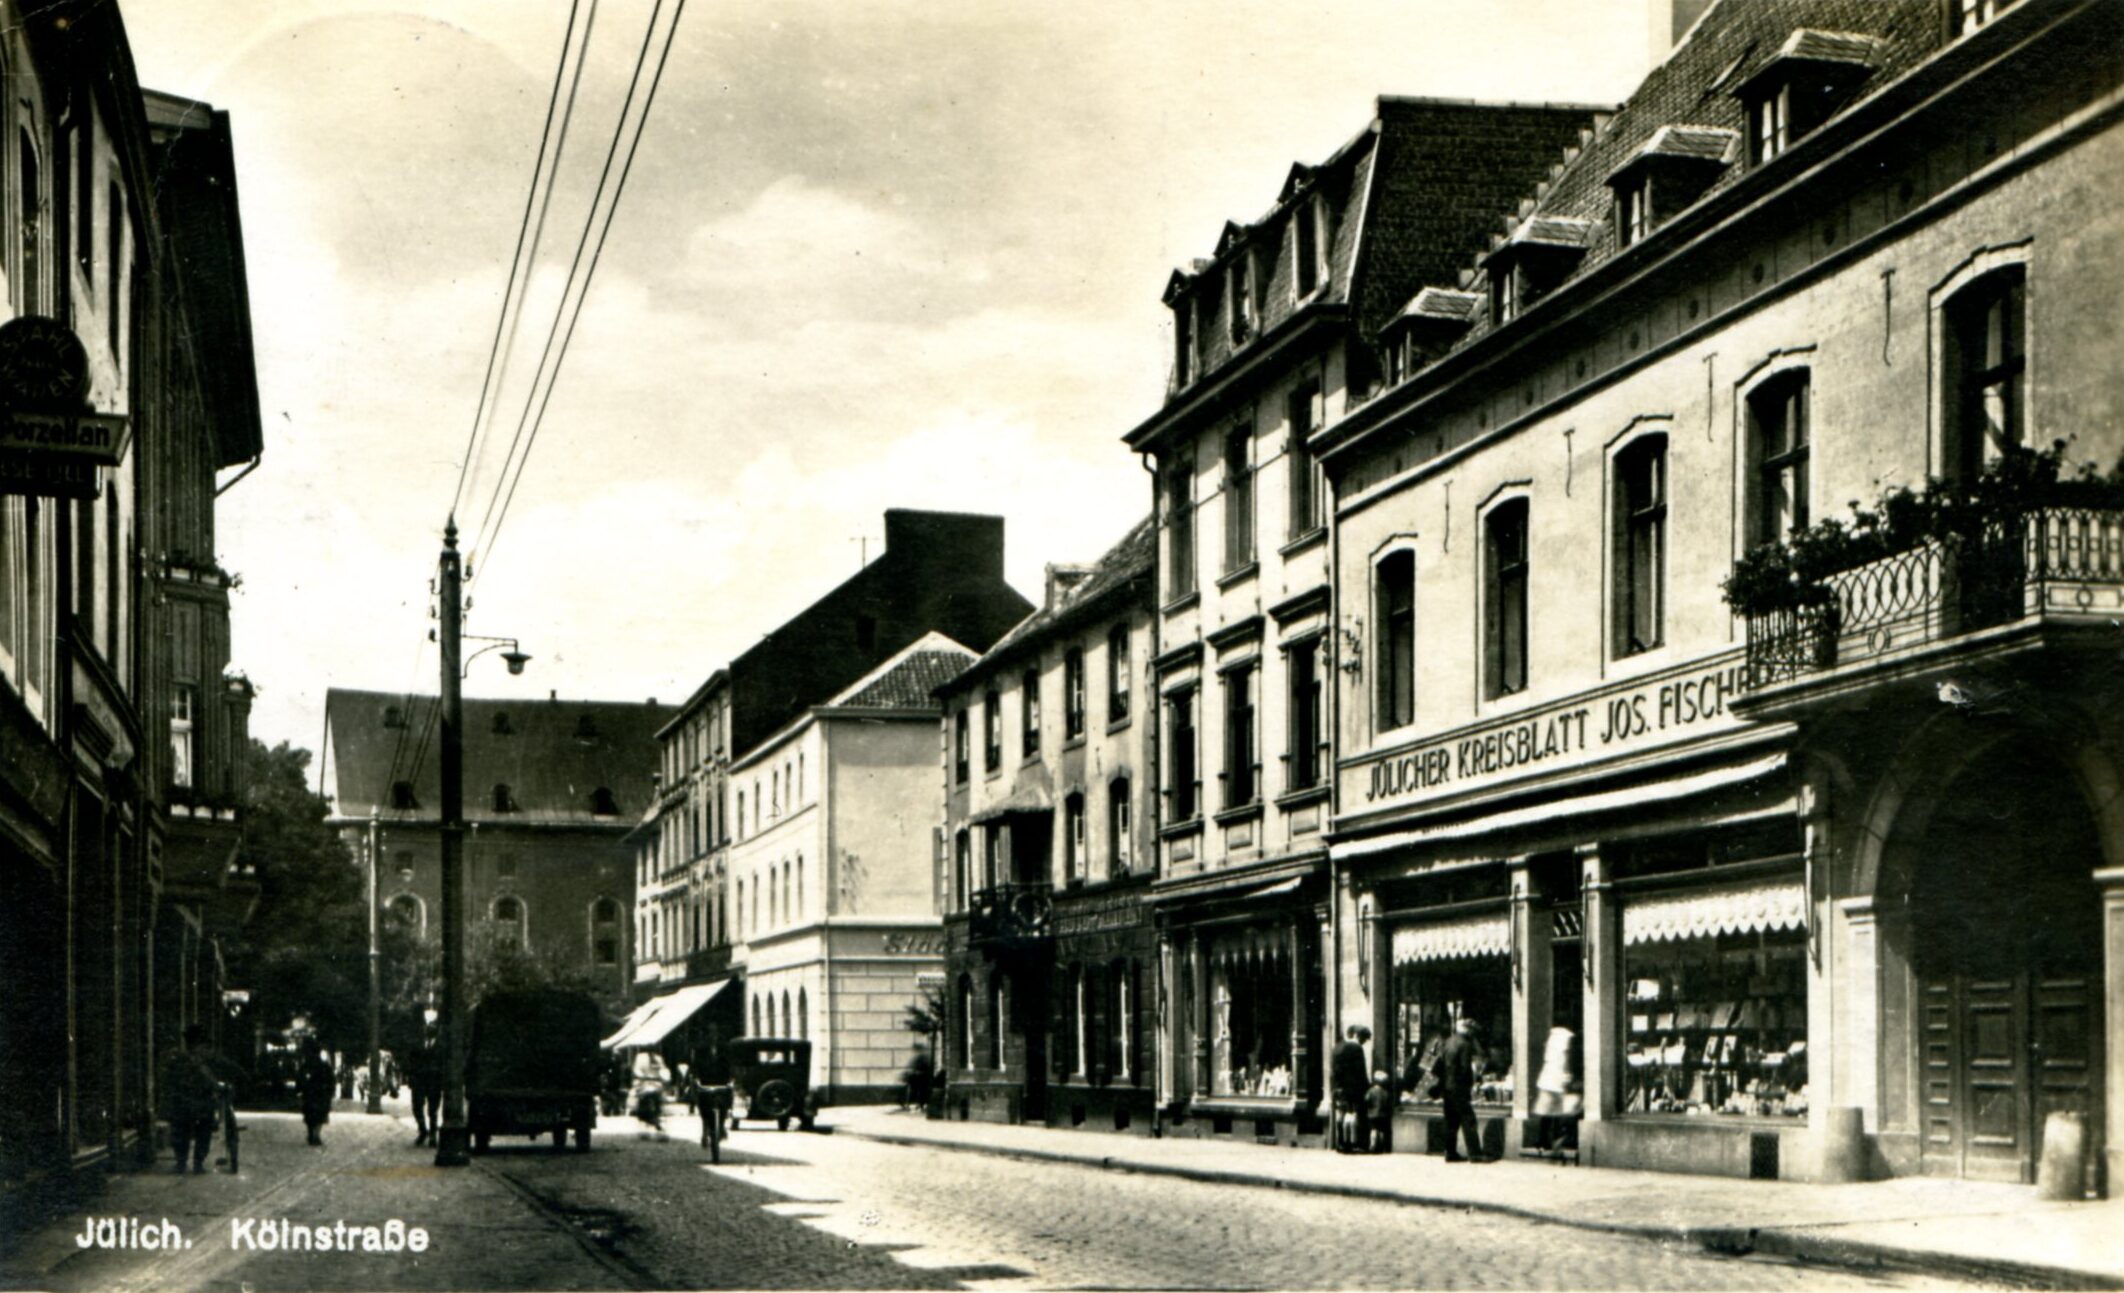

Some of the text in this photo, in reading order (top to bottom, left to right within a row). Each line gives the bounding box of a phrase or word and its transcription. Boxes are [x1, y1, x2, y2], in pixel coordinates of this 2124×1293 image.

[0, 412, 110, 447] Porzellan
[1367, 753, 1450, 802] JÜLICHER
[1458, 710, 1589, 777] KREISBLATT
[1602, 693, 1651, 743] JOS.
